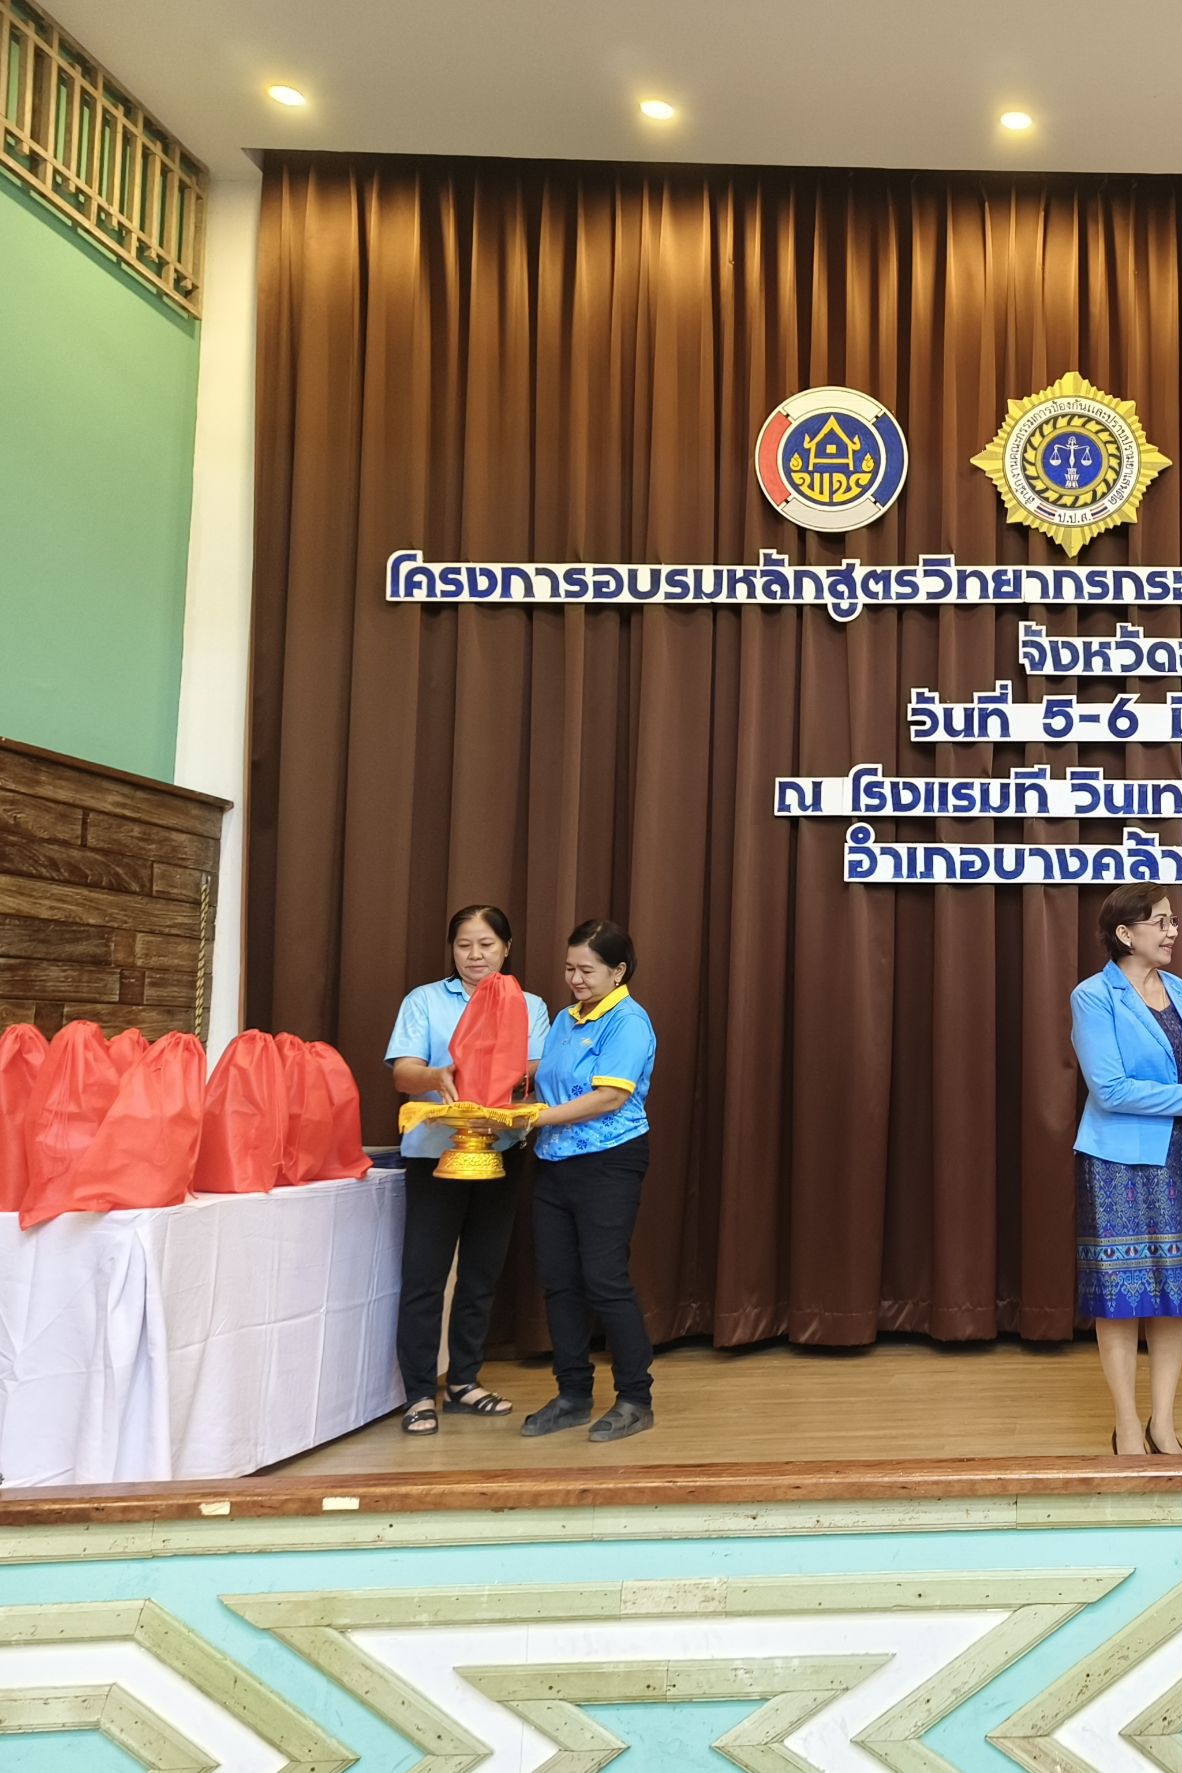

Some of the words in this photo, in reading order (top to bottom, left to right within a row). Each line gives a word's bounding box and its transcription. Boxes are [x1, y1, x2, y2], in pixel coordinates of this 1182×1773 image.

[910, 685, 1011, 739] วันที่
[1043, 698, 1139, 739] 5-6
[777, 781, 823, 813] ณ
[851, 768, 1050, 814] โรงแรมที
